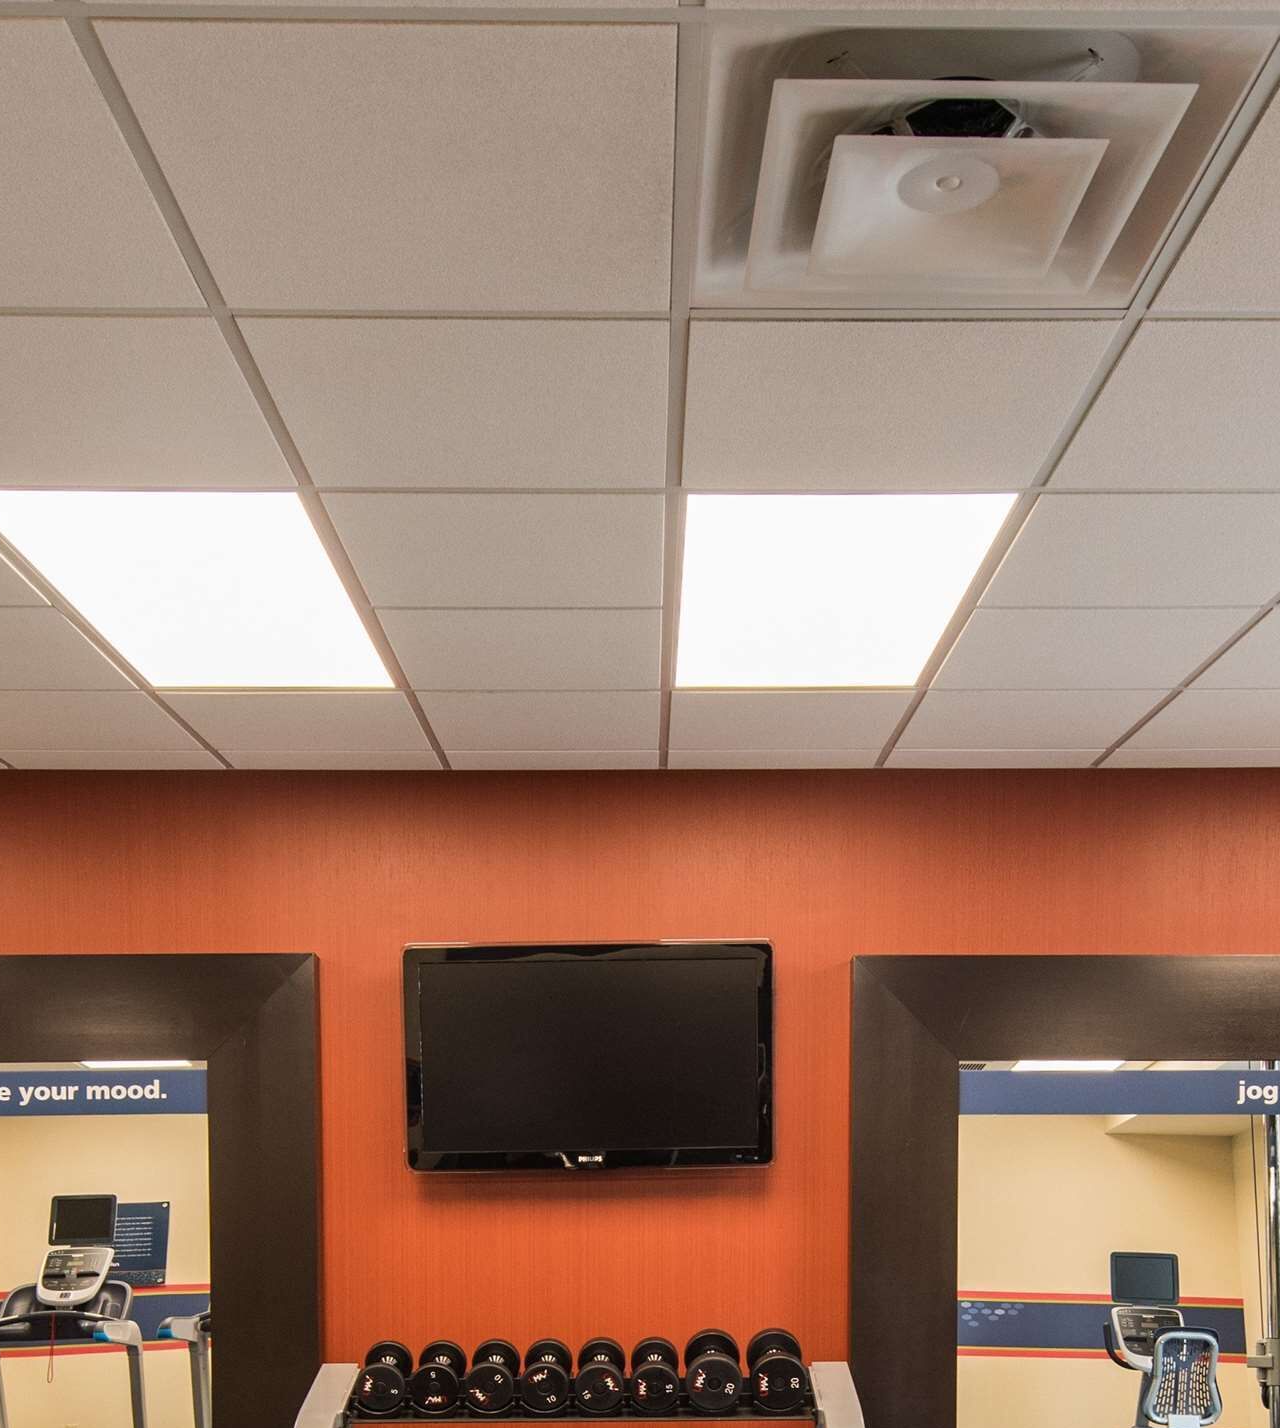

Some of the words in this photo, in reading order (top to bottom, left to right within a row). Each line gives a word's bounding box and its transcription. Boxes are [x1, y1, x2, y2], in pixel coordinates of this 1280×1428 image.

[18, 1083, 79, 1106] your
[85, 1079, 168, 1100] mood.
[1236, 1080, 1279, 1105] jog
